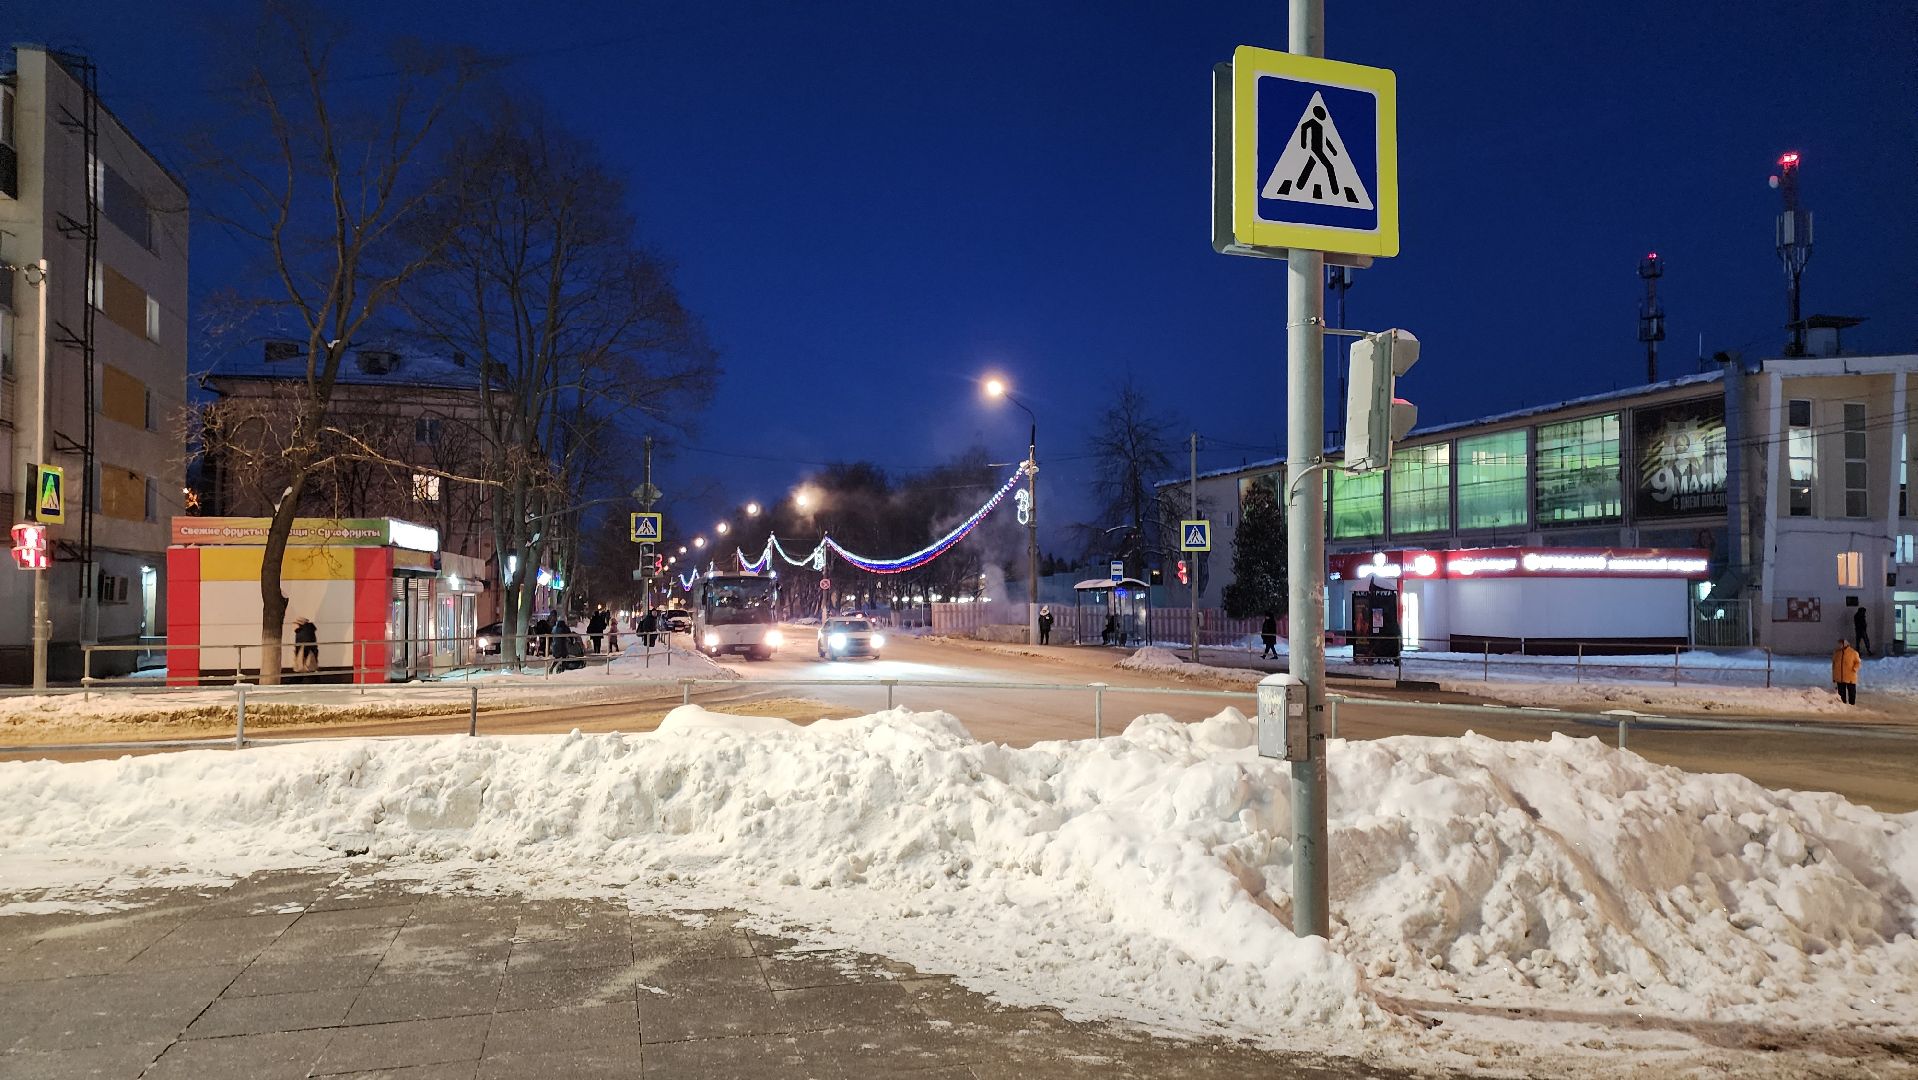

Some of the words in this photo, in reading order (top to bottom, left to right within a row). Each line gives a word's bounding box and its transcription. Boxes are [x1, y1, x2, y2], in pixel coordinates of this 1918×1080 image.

[1650, 467, 1674, 502] 9
[1674, 472, 1713, 494] МАЯ
[180, 527, 220, 537] Свежие
[222, 527, 264, 538] фрукты
